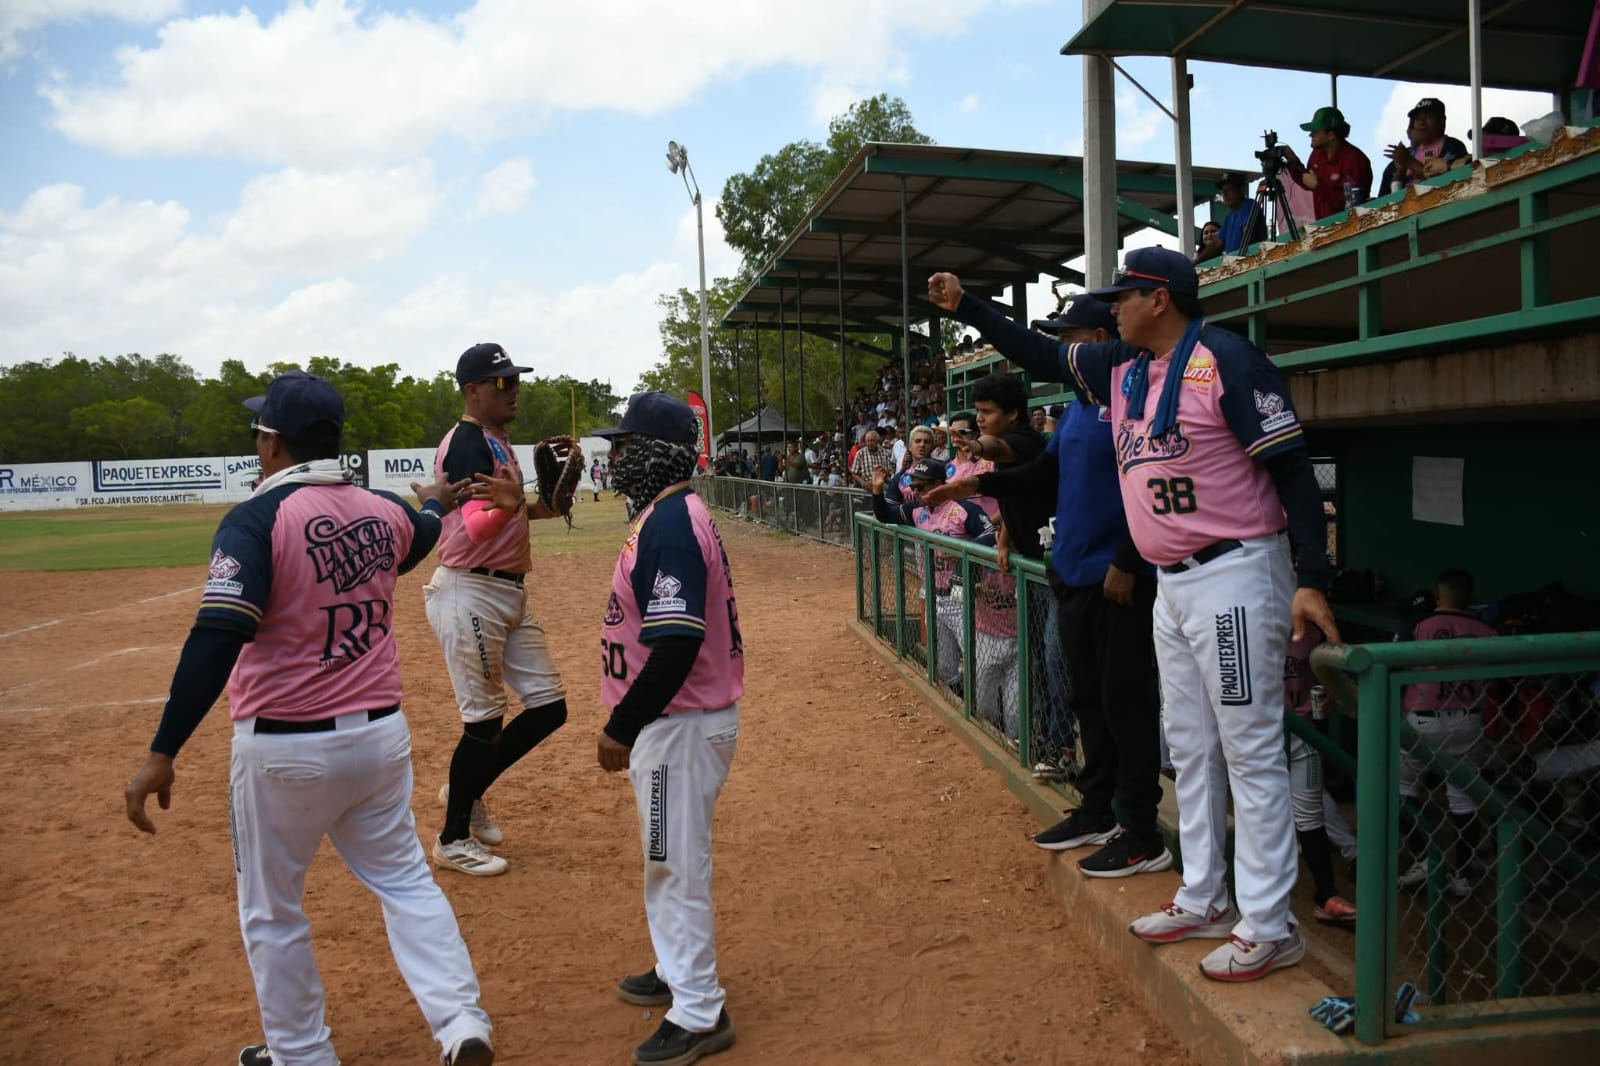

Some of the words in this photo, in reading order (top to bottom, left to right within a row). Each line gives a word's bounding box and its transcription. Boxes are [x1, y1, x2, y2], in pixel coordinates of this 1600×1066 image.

[102, 464, 213, 481] PAQUETEXPRESS
[384, 458, 425, 473] MDA
[20, 473, 78, 487] MÉXICO
[107, 496, 131, 504] JAVIER
[132, 495, 149, 503] SOTO
[150, 494, 186, 503] ESCALANTE
[1147, 476, 1198, 515] 38
[1215, 613, 1239, 695] PAQUETEXPRESS
[650, 769, 661, 851] PAQUETEXPRESS
